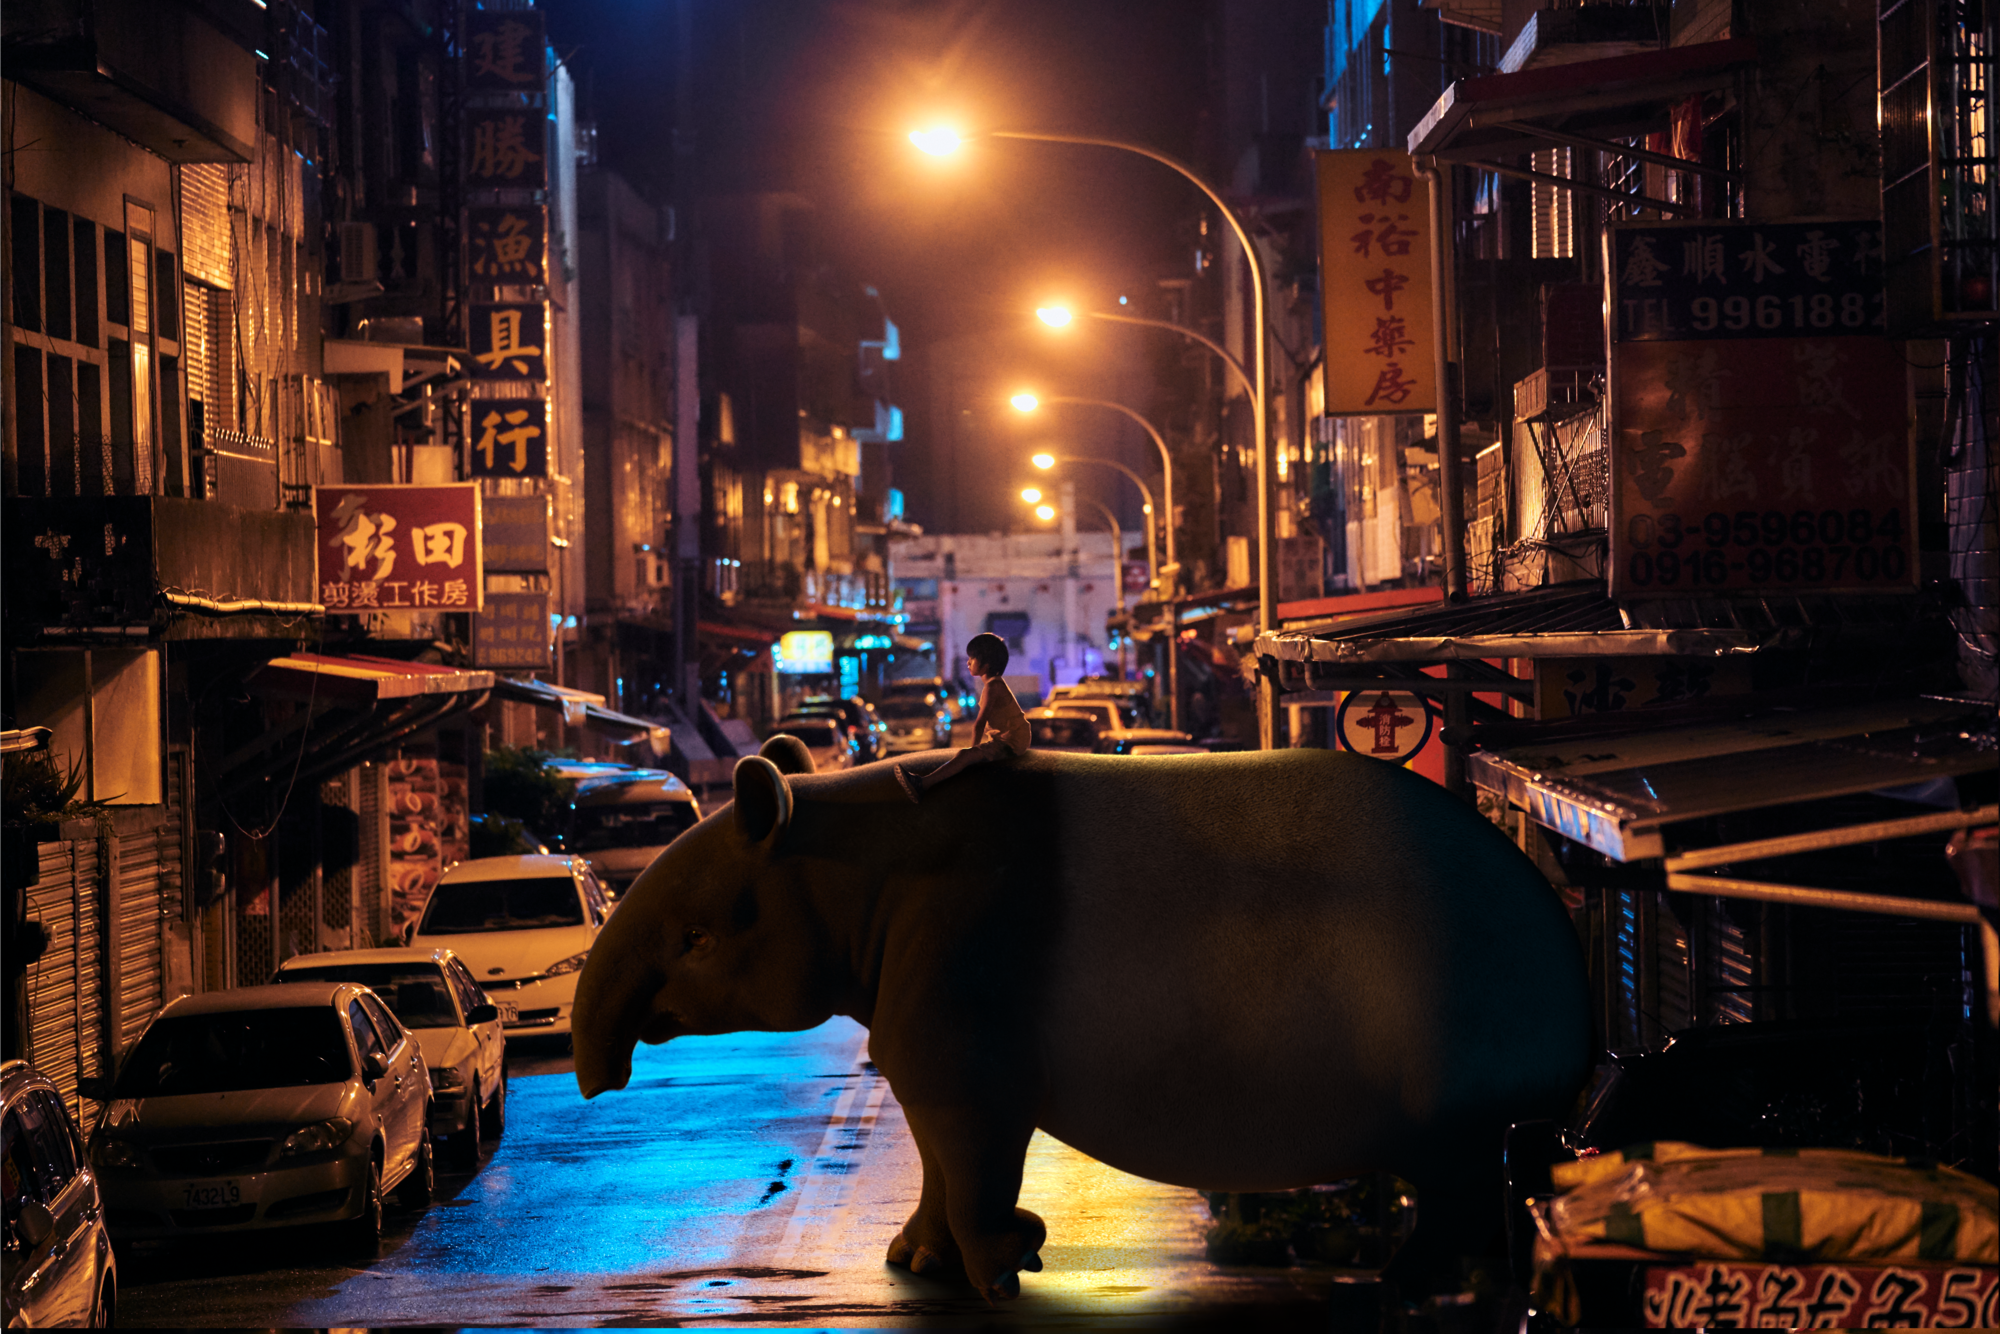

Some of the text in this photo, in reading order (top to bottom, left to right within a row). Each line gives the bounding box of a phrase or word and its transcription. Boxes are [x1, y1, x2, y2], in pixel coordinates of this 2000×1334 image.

[470, 20, 541, 472] 建勝漁具行
[1351, 158, 1419, 406] 南裕中藥房
[1626, 426, 1905, 508] 電腦資訊
[1628, 508, 1905, 549] 03-9596084
[1629, 545, 1906, 586] 0916-968700
[322, 579, 469, 608] 剪燙工作房
[1379, 713, 1391, 747] 消防栓
